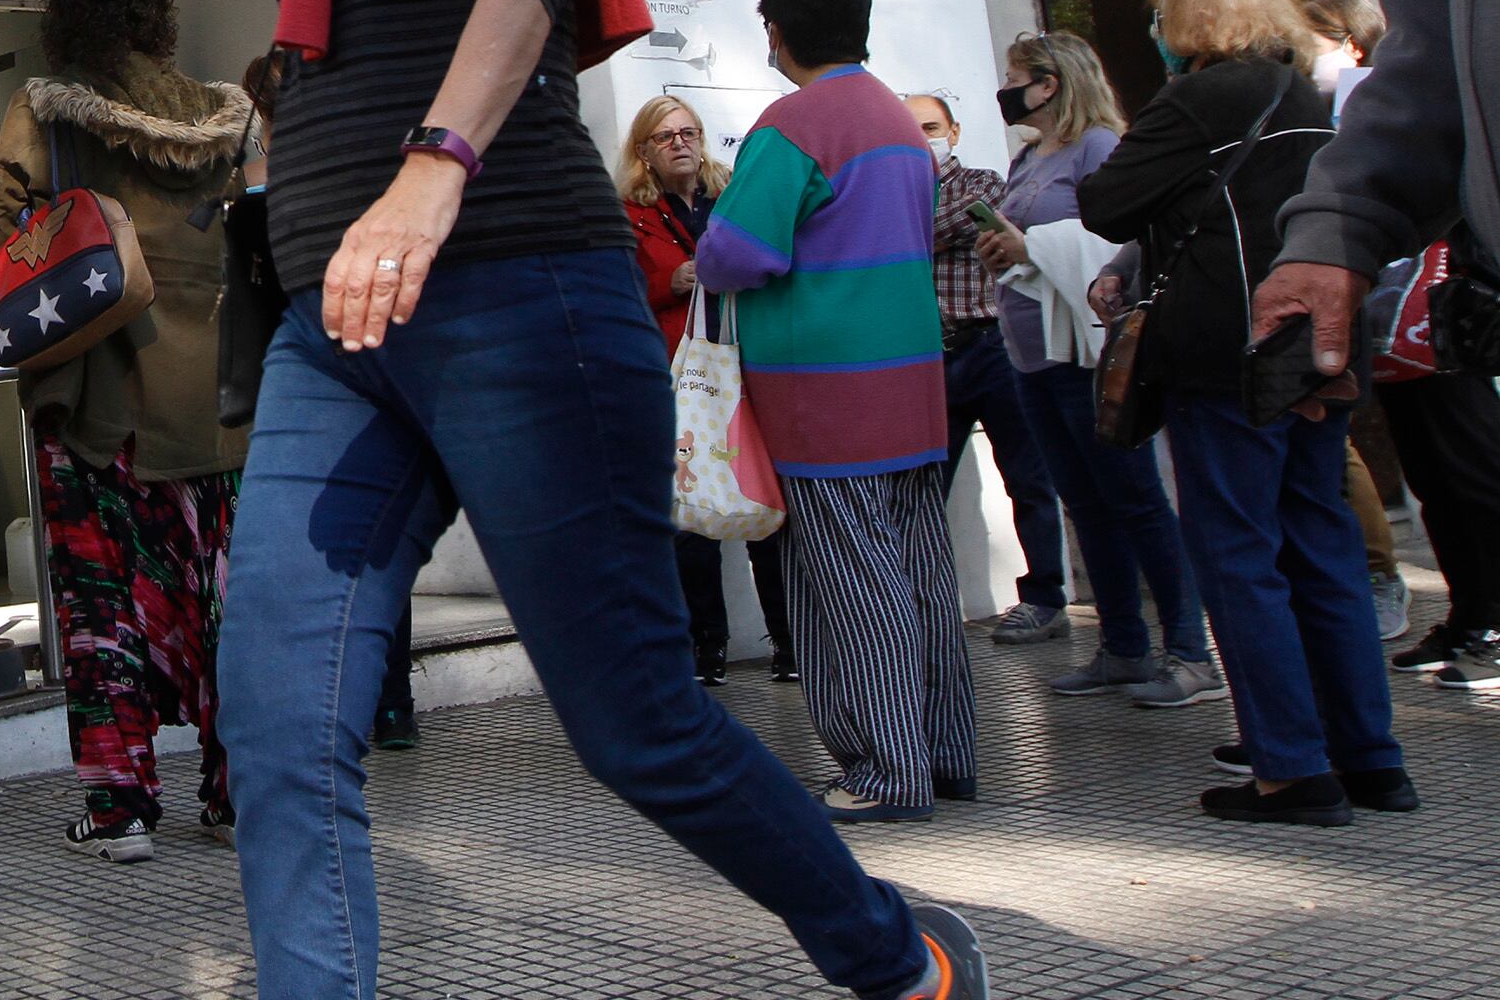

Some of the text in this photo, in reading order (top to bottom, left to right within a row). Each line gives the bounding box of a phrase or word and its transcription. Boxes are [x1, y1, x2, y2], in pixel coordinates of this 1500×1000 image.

[659, 3, 690, 15] TURNO
[686, 368, 707, 378] nous
[680, 381, 688, 389] le
